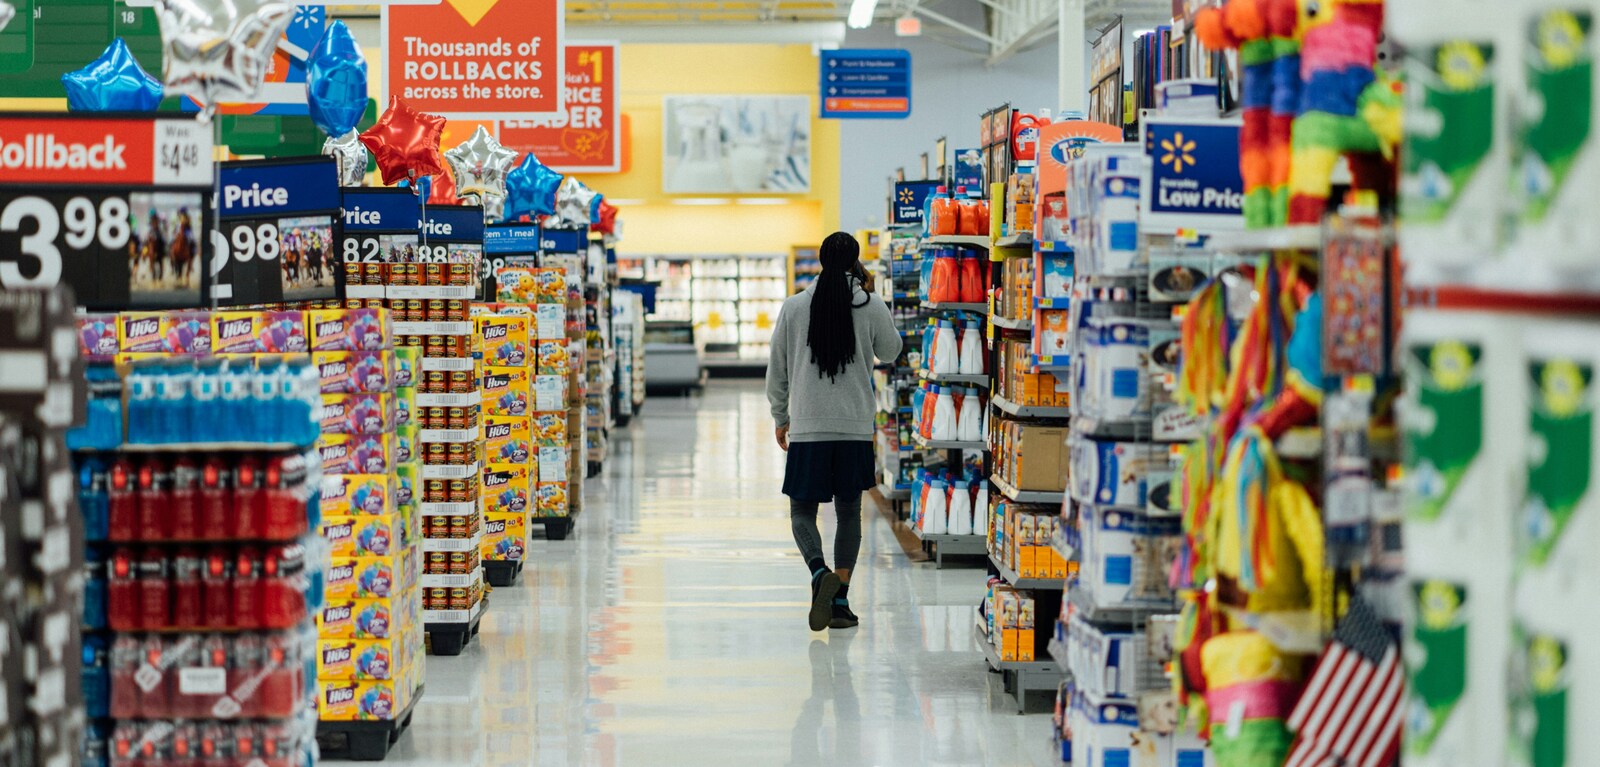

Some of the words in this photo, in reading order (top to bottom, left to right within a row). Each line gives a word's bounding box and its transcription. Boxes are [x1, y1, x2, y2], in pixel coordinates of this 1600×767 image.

[403, 36, 512, 57] Thousands
[517, 36, 541, 57] of
[404, 61, 543, 80] ROLLBACKS
[578, 50, 603, 84] #1
[403, 86, 458, 99] across
[462, 83, 492, 99] the
[495, 85, 544, 99] store.
[0, 134, 127, 169] ollback
[224, 182, 289, 209] Price
[1159, 188, 1201, 207] Low
[1203, 187, 1245, 209] Pric
[514, 228, 535, 237] meal
[343, 238, 380, 263] 82
[418, 245, 447, 263] 88
